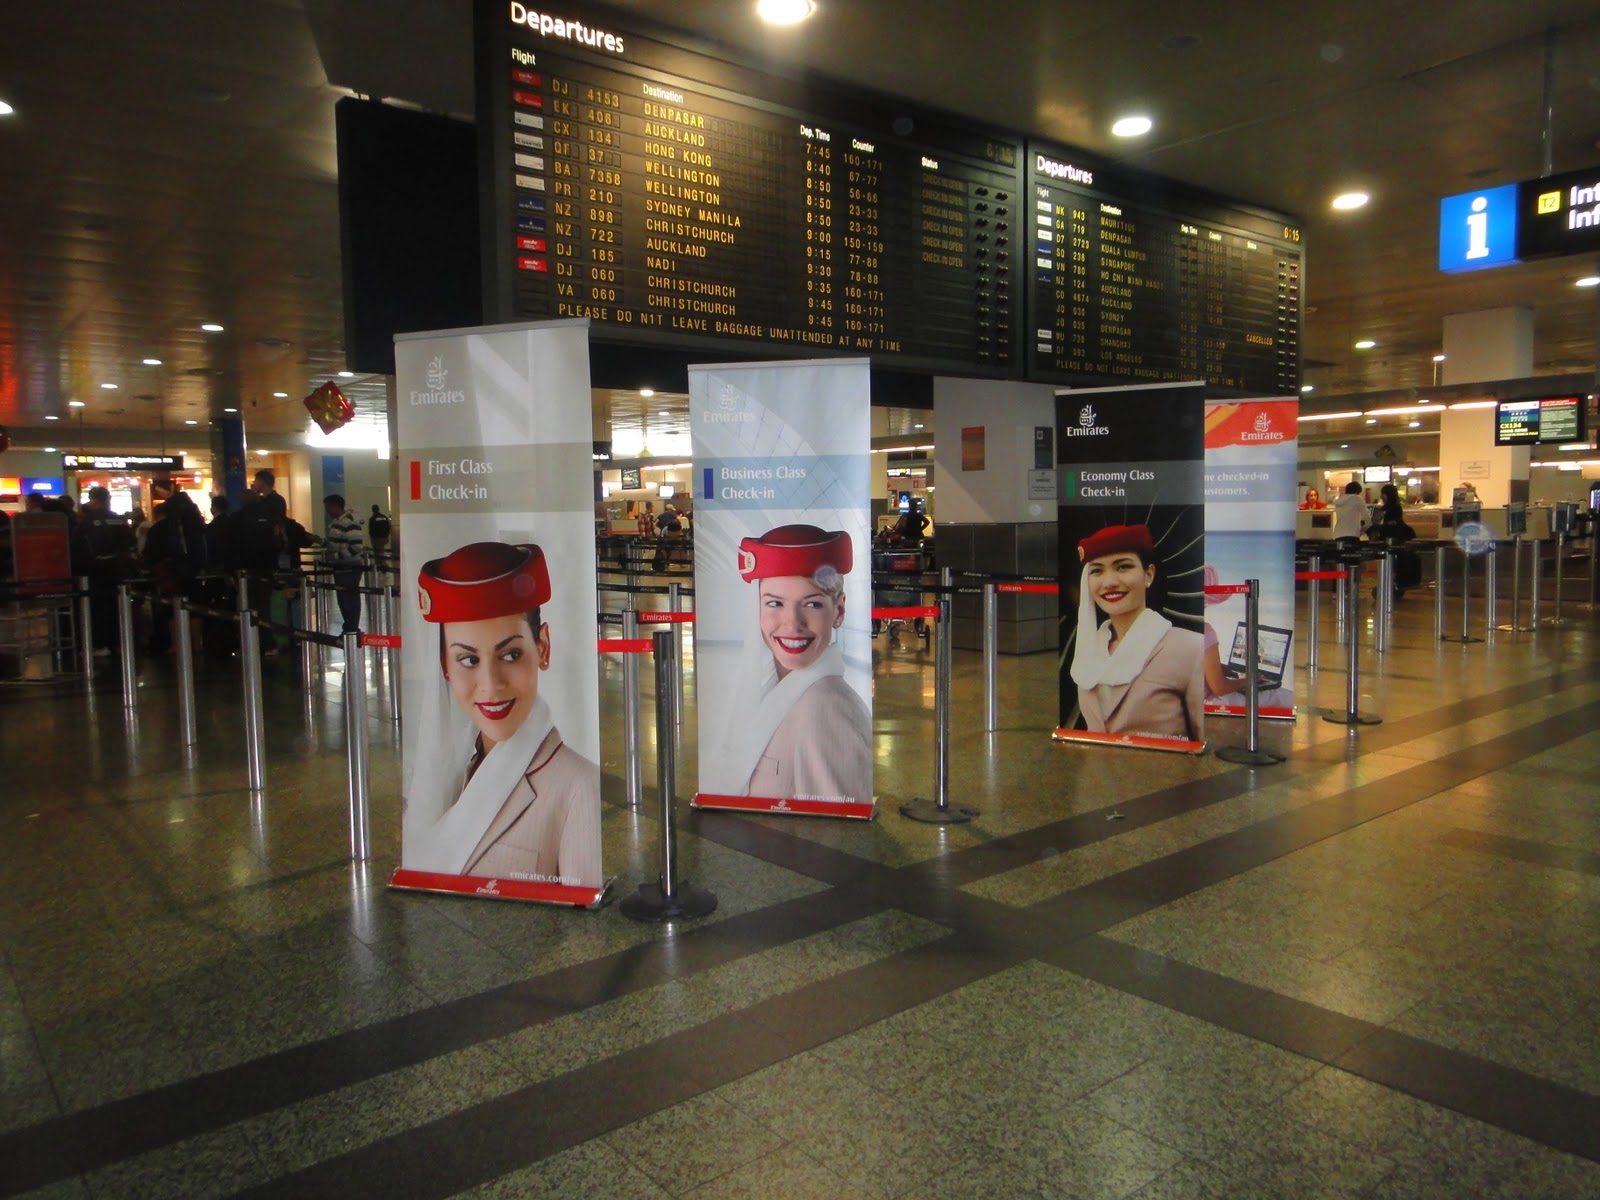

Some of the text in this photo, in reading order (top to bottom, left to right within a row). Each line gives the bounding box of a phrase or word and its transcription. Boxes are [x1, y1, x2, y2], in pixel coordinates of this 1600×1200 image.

[511, 1, 624, 53] Departures
[512, 48, 536, 65] Flight
[643, 83, 684, 104] Destination
[553, 79, 568, 95] DJ
[587, 88, 620, 108] 4153
[644, 103, 705, 128] DENPASAR
[806, 144, 830, 159] 7:45
[554, 100, 570, 116] EK
[588, 109, 612, 126] 406
[645, 124, 705, 147] AUCKLAND
[807, 160, 830, 176] 8:40
[816, 128, 830, 142] Time
[852, 138, 874, 152] Counter
[554, 120, 570, 136] CX
[589, 128, 612, 145] 134
[645, 142, 675, 160] HONG
[683, 150, 712, 168] KONG
[807, 178, 831, 192] 8:50
[1037, 155, 1092, 184] Departures
[588, 146, 604, 162] 37
[645, 160, 720, 188] WELLINGTON
[807, 195, 831, 210] 8:50
[850, 204, 878, 220] 23-33
[554, 161, 571, 177] BA
[590, 168, 621, 186] 7358
[645, 180, 720, 206] WELLINGTON
[807, 212, 831, 227] 8:50
[850, 221, 878, 236] 23-33
[1037, 187, 1050, 198] Flight
[1542, 197, 1556, 208] T2
[555, 182, 572, 197] PR
[590, 188, 613, 204] 210
[646, 200, 690, 219] SYDNEY
[699, 209, 741, 228] MANILA
[807, 230, 831, 244] 9:00
[844, 236, 884, 254] 150-159
[922, 250, 940, 263] CHECK
[1073, 210, 1086, 220] 943
[555, 202, 572, 216] NZ
[590, 208, 614, 224] 898
[646, 218, 734, 244] CHRISTCHURCH
[807, 246, 831, 261] 9:15
[850, 254, 878, 268] 77-88
[1056, 220, 1064, 230] GA
[1100, 230, 1132, 245] DENPASAR
[1284, 226, 1300, 242] 6:15
[1056, 234, 1064, 244] D7
[1073, 238, 1090, 250] 2723
[1101, 244, 1121, 256] KUALA
[556, 223, 572, 236] NZ
[590, 228, 614, 244] 722
[647, 238, 706, 258] AUCKLAND
[808, 263, 832, 277] 9:30
[850, 270, 878, 285] 78-88
[557, 243, 884, 302] DJ 185 NADI 9:35 160-171
[1056, 262, 1066, 272] VN
[1112, 274, 1124, 283] CHI
[1101, 258, 1135, 272] SINGAPORE
[557, 264, 884, 318] DJ 060 CHRISTCHURCH 9:45 160-171
[1056, 276, 1132, 298] NZ 124 AUCKLAND
[558, 283, 884, 334] VA 060 CHRISTCHURCH 9:45 160-171
[1101, 298, 1132, 311] AUCKLAND
[1101, 311, 1124, 322] SYDNEY
[558, 303, 608, 320] PLEASE
[616, 310, 632, 322] DO
[672, 316, 708, 331] LEAVE
[716, 321, 762, 337] BAGGAGE
[770, 328, 832, 344] UNATTENDED
[838, 336, 850, 346] AT
[856, 338, 873, 348] ANY
[880, 339, 900, 352] TIME
[1246, 333, 1273, 346] CANCELLED
[410, 389, 465, 406] Emirates
[1066, 426, 1109, 437] Emirates
[1241, 432, 1284, 442] Emirates
[428, 458, 494, 476] First Class
[722, 466, 806, 480] Business Class
[1081, 469, 1154, 482] Economy Class
[1217, 472, 1270, 482] checked-in
[428, 484, 488, 500] Check-in
[722, 486, 775, 500] Check-in
[1081, 486, 1125, 498] Check-in
[1204, 487, 1250, 496] ustomers.
[641, 614, 672, 622] Emirates
[794, 794, 855, 804] emirates.com/au
[510, 872, 581, 886] emirates.com/au
